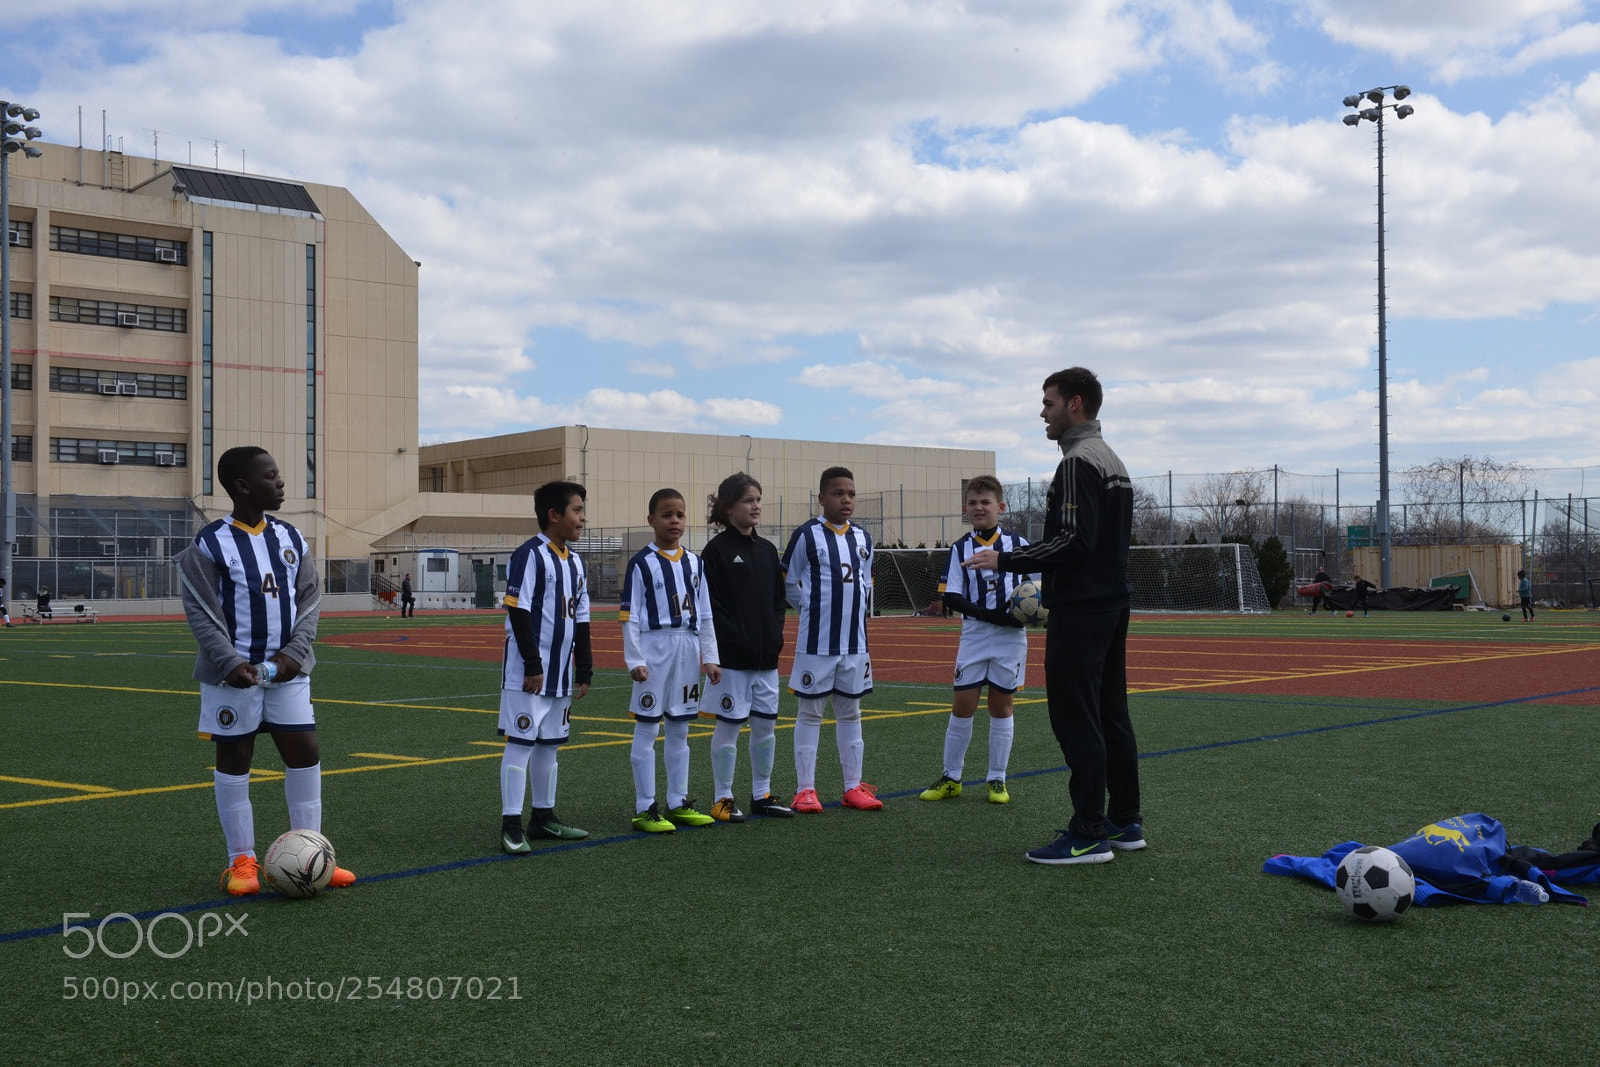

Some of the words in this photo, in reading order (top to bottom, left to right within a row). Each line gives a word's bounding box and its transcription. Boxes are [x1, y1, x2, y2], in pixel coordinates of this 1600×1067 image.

[840, 562, 854, 583] 2
[260, 573, 280, 598] 4
[561, 594, 576, 619] 16
[672, 592, 693, 618] 14
[683, 683, 699, 704] 14
